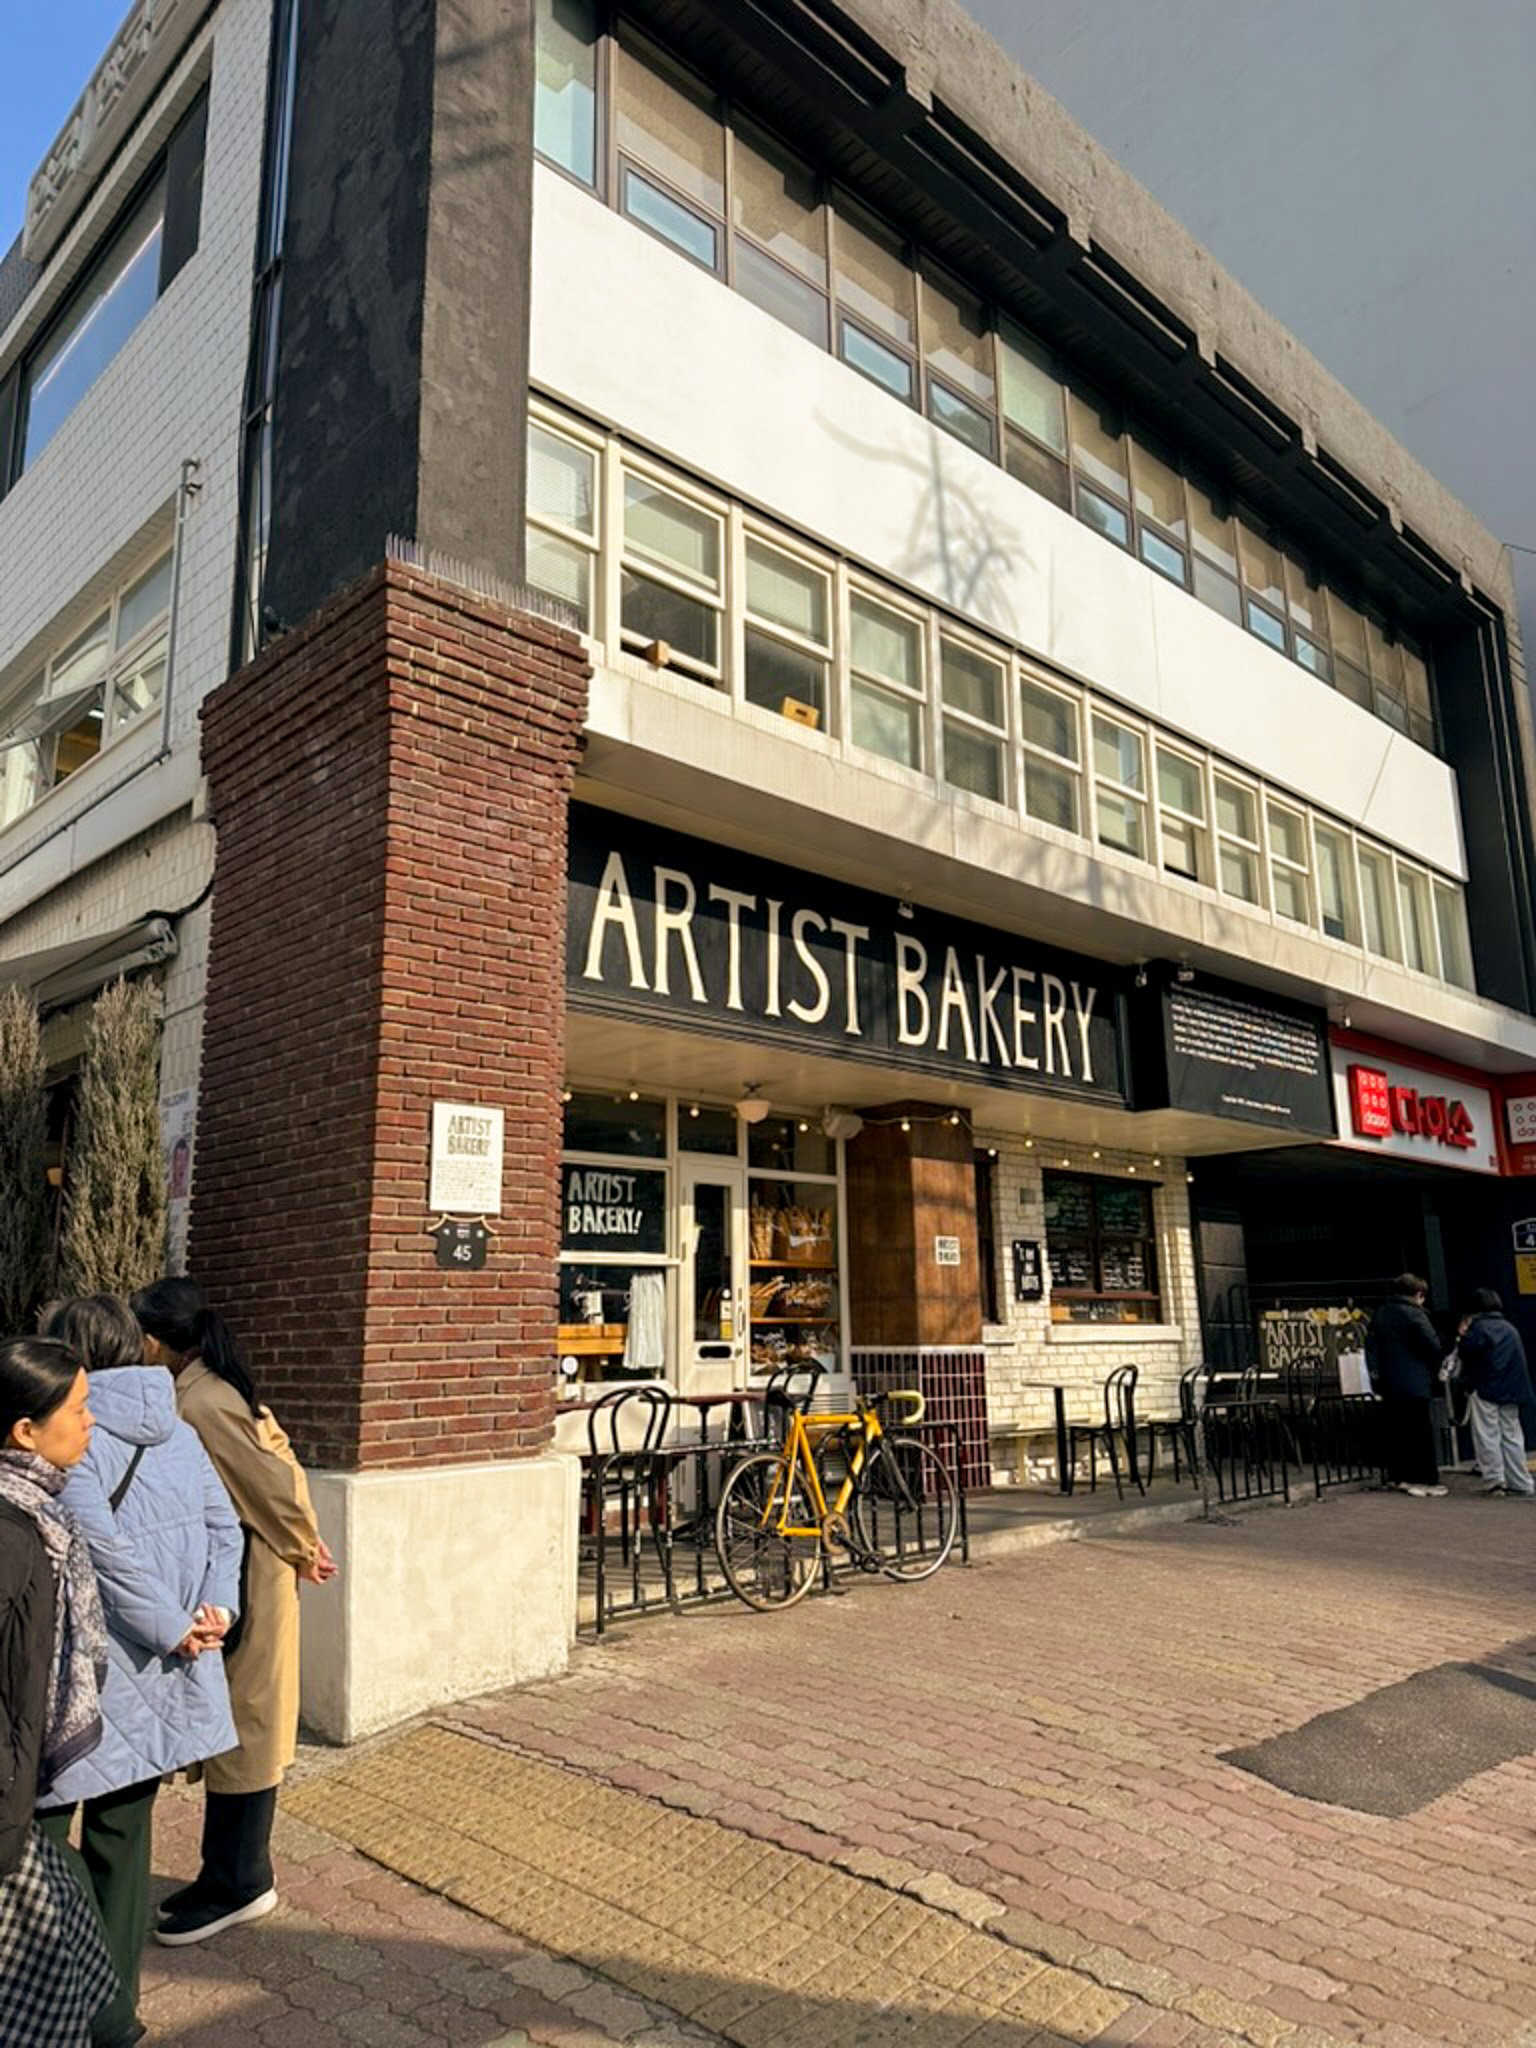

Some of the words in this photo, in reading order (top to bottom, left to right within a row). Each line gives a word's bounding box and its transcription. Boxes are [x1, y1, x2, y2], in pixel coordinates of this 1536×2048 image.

[583, 851, 870, 1036] ARTIST
[894, 931, 1098, 1083] BAKERY
[447, 1115, 493, 1137] ARTIST
[1390, 1086, 1477, 1149] 다이소
[447, 1135, 491, 1156] BAKERY
[568, 1171, 637, 1204] ARTIST
[568, 1205, 643, 1235] BAKERY!
[453, 1245, 472, 1261] 45
[1265, 1320, 1324, 1347] ARTIST
